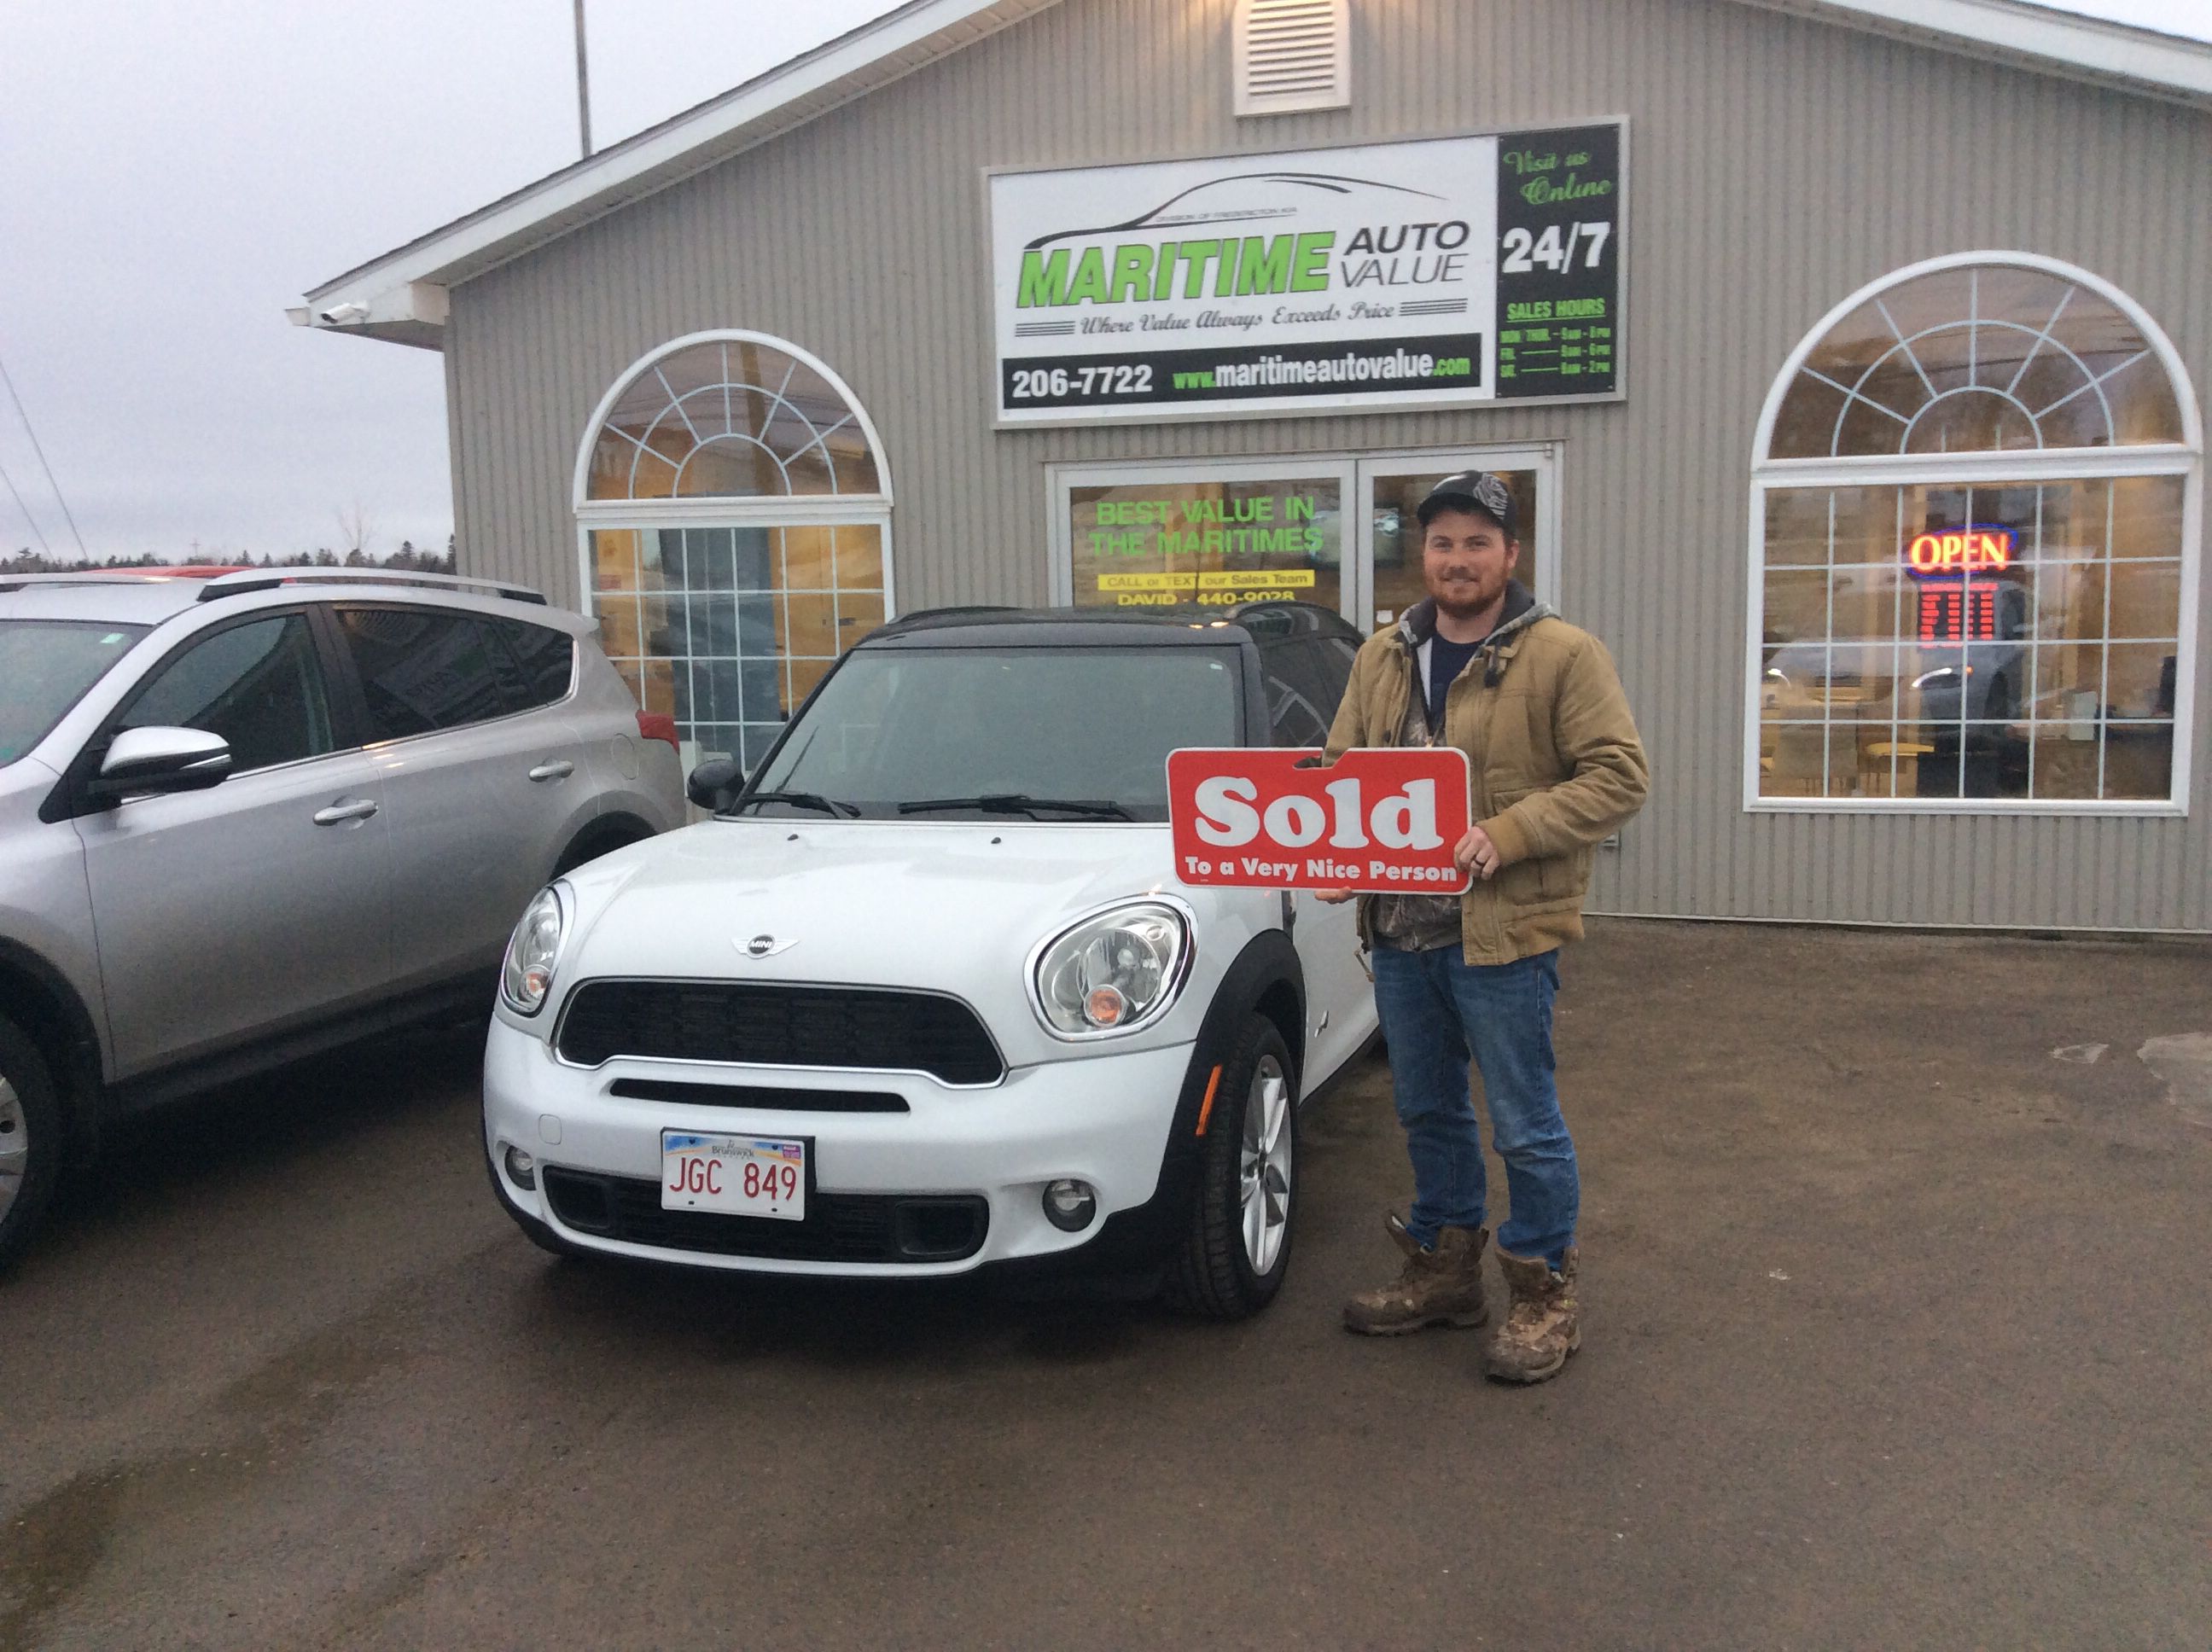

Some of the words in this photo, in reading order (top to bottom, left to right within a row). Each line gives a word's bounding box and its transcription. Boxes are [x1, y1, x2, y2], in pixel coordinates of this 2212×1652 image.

[1520, 172, 1612, 205] Online
[1016, 230, 1336, 309] MARITIME
[1342, 220, 1470, 256] AUTO
[1502, 222, 1611, 275] 24/7
[1341, 253, 1470, 288] VALUE
[1080, 317, 1134, 335] Where
[1139, 313, 1190, 331] Value
[1196, 310, 1263, 332] Always
[1272, 304, 1341, 324] Exceeds
[1348, 301, 1395, 321] Price
[1507, 300, 1552, 320] SALES
[1556, 298, 1605, 317] HOURS
[1011, 364, 1153, 398] 206-7722
[1173, 348, 1470, 389] www.maritimeautovalue.com
[1097, 501, 1173, 526] BEST
[1180, 497, 1274, 523] VALUE
[1285, 496, 1314, 520] IN
[1088, 532, 1146, 556] THE
[1157, 526, 1324, 554] MARITIMES
[1910, 535, 2009, 572] OPEN
[1107, 577, 1142, 587] CALL
[1205, 575, 1225, 585] our
[1231, 574, 1268, 585] Sales
[1273, 573, 1307, 584] Team
[1118, 594, 1178, 605] DAVID
[1195, 776, 1445, 850] Sold
[1185, 856, 1212, 875] To
[1220, 860, 1235, 875] a
[1241, 857, 1298, 882] Very
[1307, 858, 1360, 879] Nice
[1369, 860, 1457, 881] Person
[669, 1157, 723, 1195] JGC
[743, 1162, 797, 1201] 849
